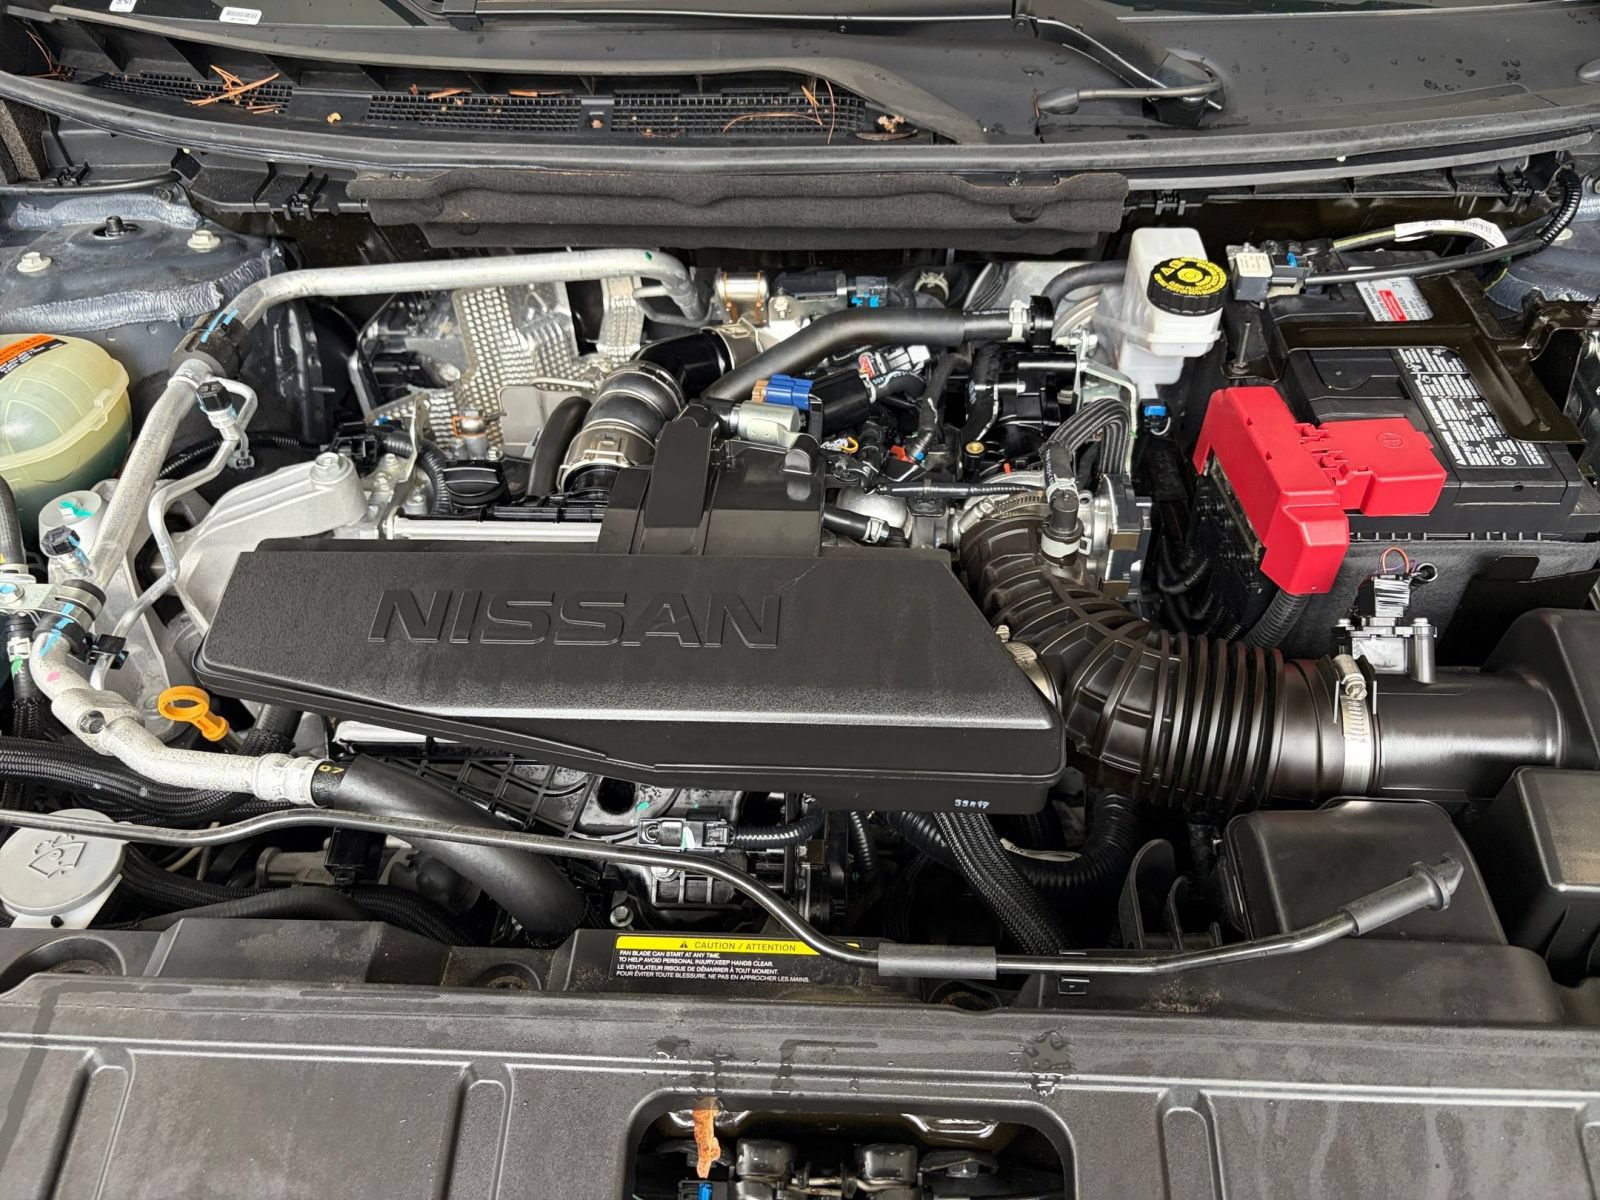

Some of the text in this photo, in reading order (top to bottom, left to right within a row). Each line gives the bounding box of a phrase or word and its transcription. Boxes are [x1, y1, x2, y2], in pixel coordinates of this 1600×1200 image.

[367, 590, 782, 649] NISSAN
[694, 941, 736, 950] CAUTION
[745, 943, 796, 952] ATTENTION
[634, 969, 655, 978] ÉVITER
[740, 974, 777, 982] APPROCHER
[696, 964, 729, 973] DÉMARRER
[751, 967, 778, 975] MOMENT.
